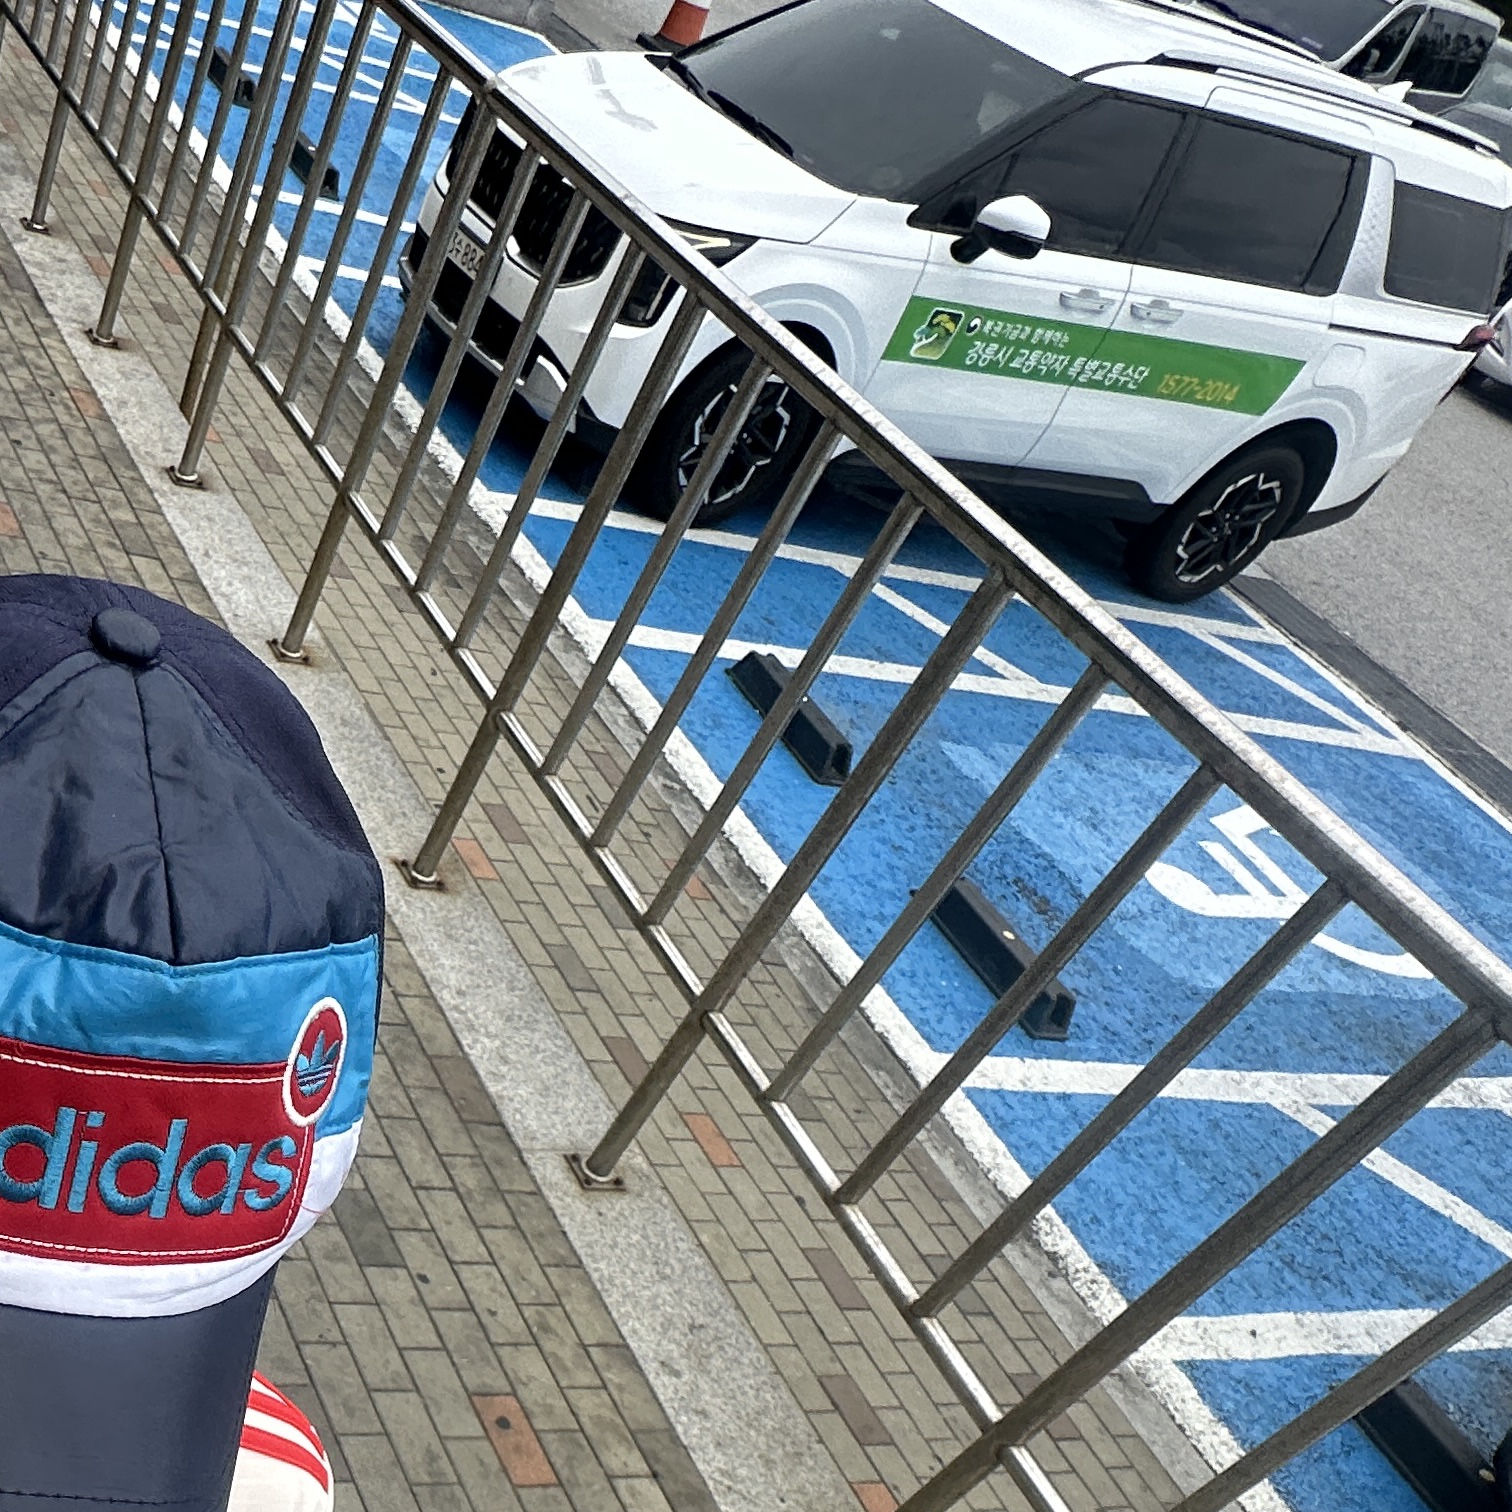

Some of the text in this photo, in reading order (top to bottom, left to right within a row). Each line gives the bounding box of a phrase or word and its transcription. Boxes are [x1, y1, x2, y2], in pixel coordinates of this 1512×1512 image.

[965, 341, 1241, 404] 강릉시 교통약자 특별교통수단 1577-2014
